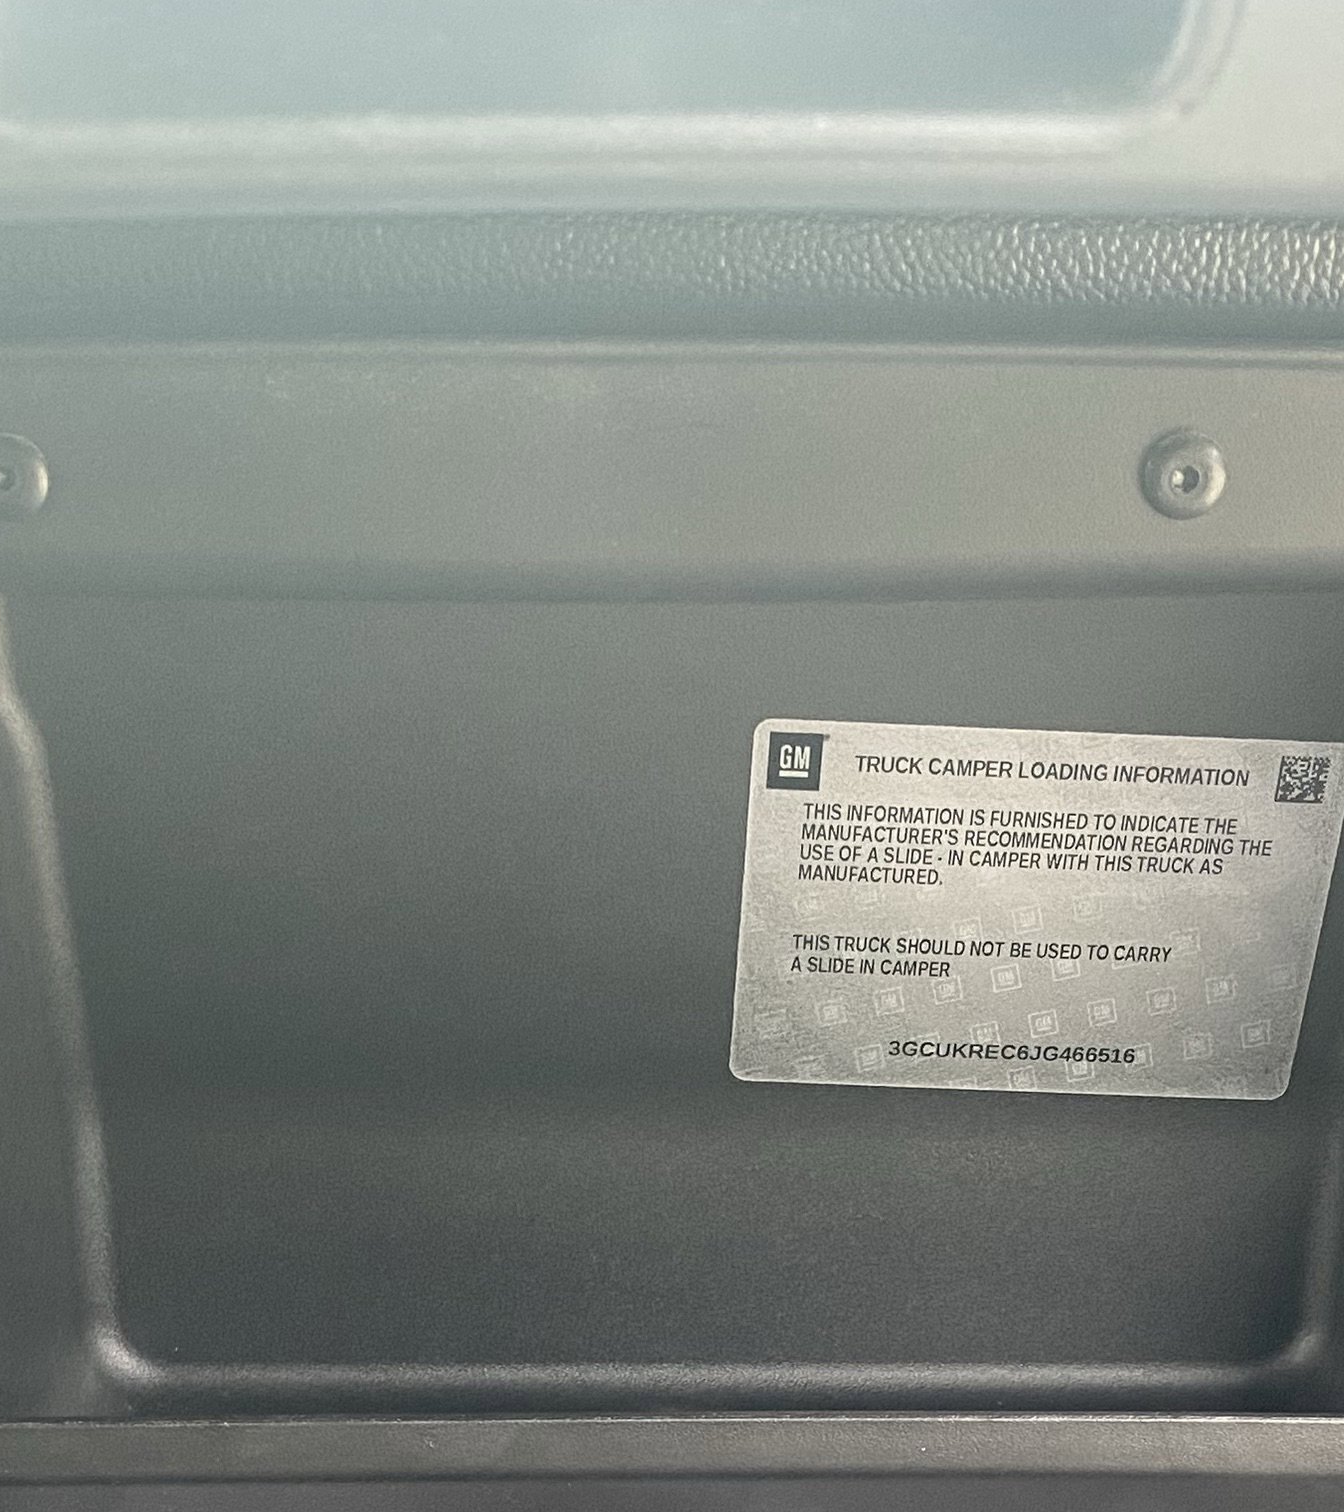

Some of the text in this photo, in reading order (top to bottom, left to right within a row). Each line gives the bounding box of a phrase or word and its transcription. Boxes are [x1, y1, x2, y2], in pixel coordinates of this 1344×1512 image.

[779, 744, 811, 770] GM
[855, 755, 1251, 787] TRUCK CAMPER LOADING INFORMATION
[803, 802, 1239, 835] THIS INFORMATION IS FURNISHED TO INDICATE THE
[801, 823, 1273, 857] MANUFACTURER'S RECOMMENDATION REGARDING THE
[799, 844, 835, 861] USE
[839, 845, 863, 863] OF
[866, 847, 879, 863] A
[883, 847, 934, 866] SLIDE
[947, 849, 964, 866] IN
[969, 850, 1042, 870] CAMPER
[1046, 853, 1090, 871] WITH
[1094, 854, 1133, 872] THIS
[1137, 856, 1196, 875] TRUCK
[1198, 858, 1225, 875] AS
[798, 864, 944, 886] MANUFACTURED.
[792, 934, 1173, 963] THIS TRUCK SHOULD NOT BE USED TO CARRY
[790, 956, 951, 978] A SLIDE IN CAMPER
[888, 1040, 1136, 1065] 3GCUKREC6JG466516
